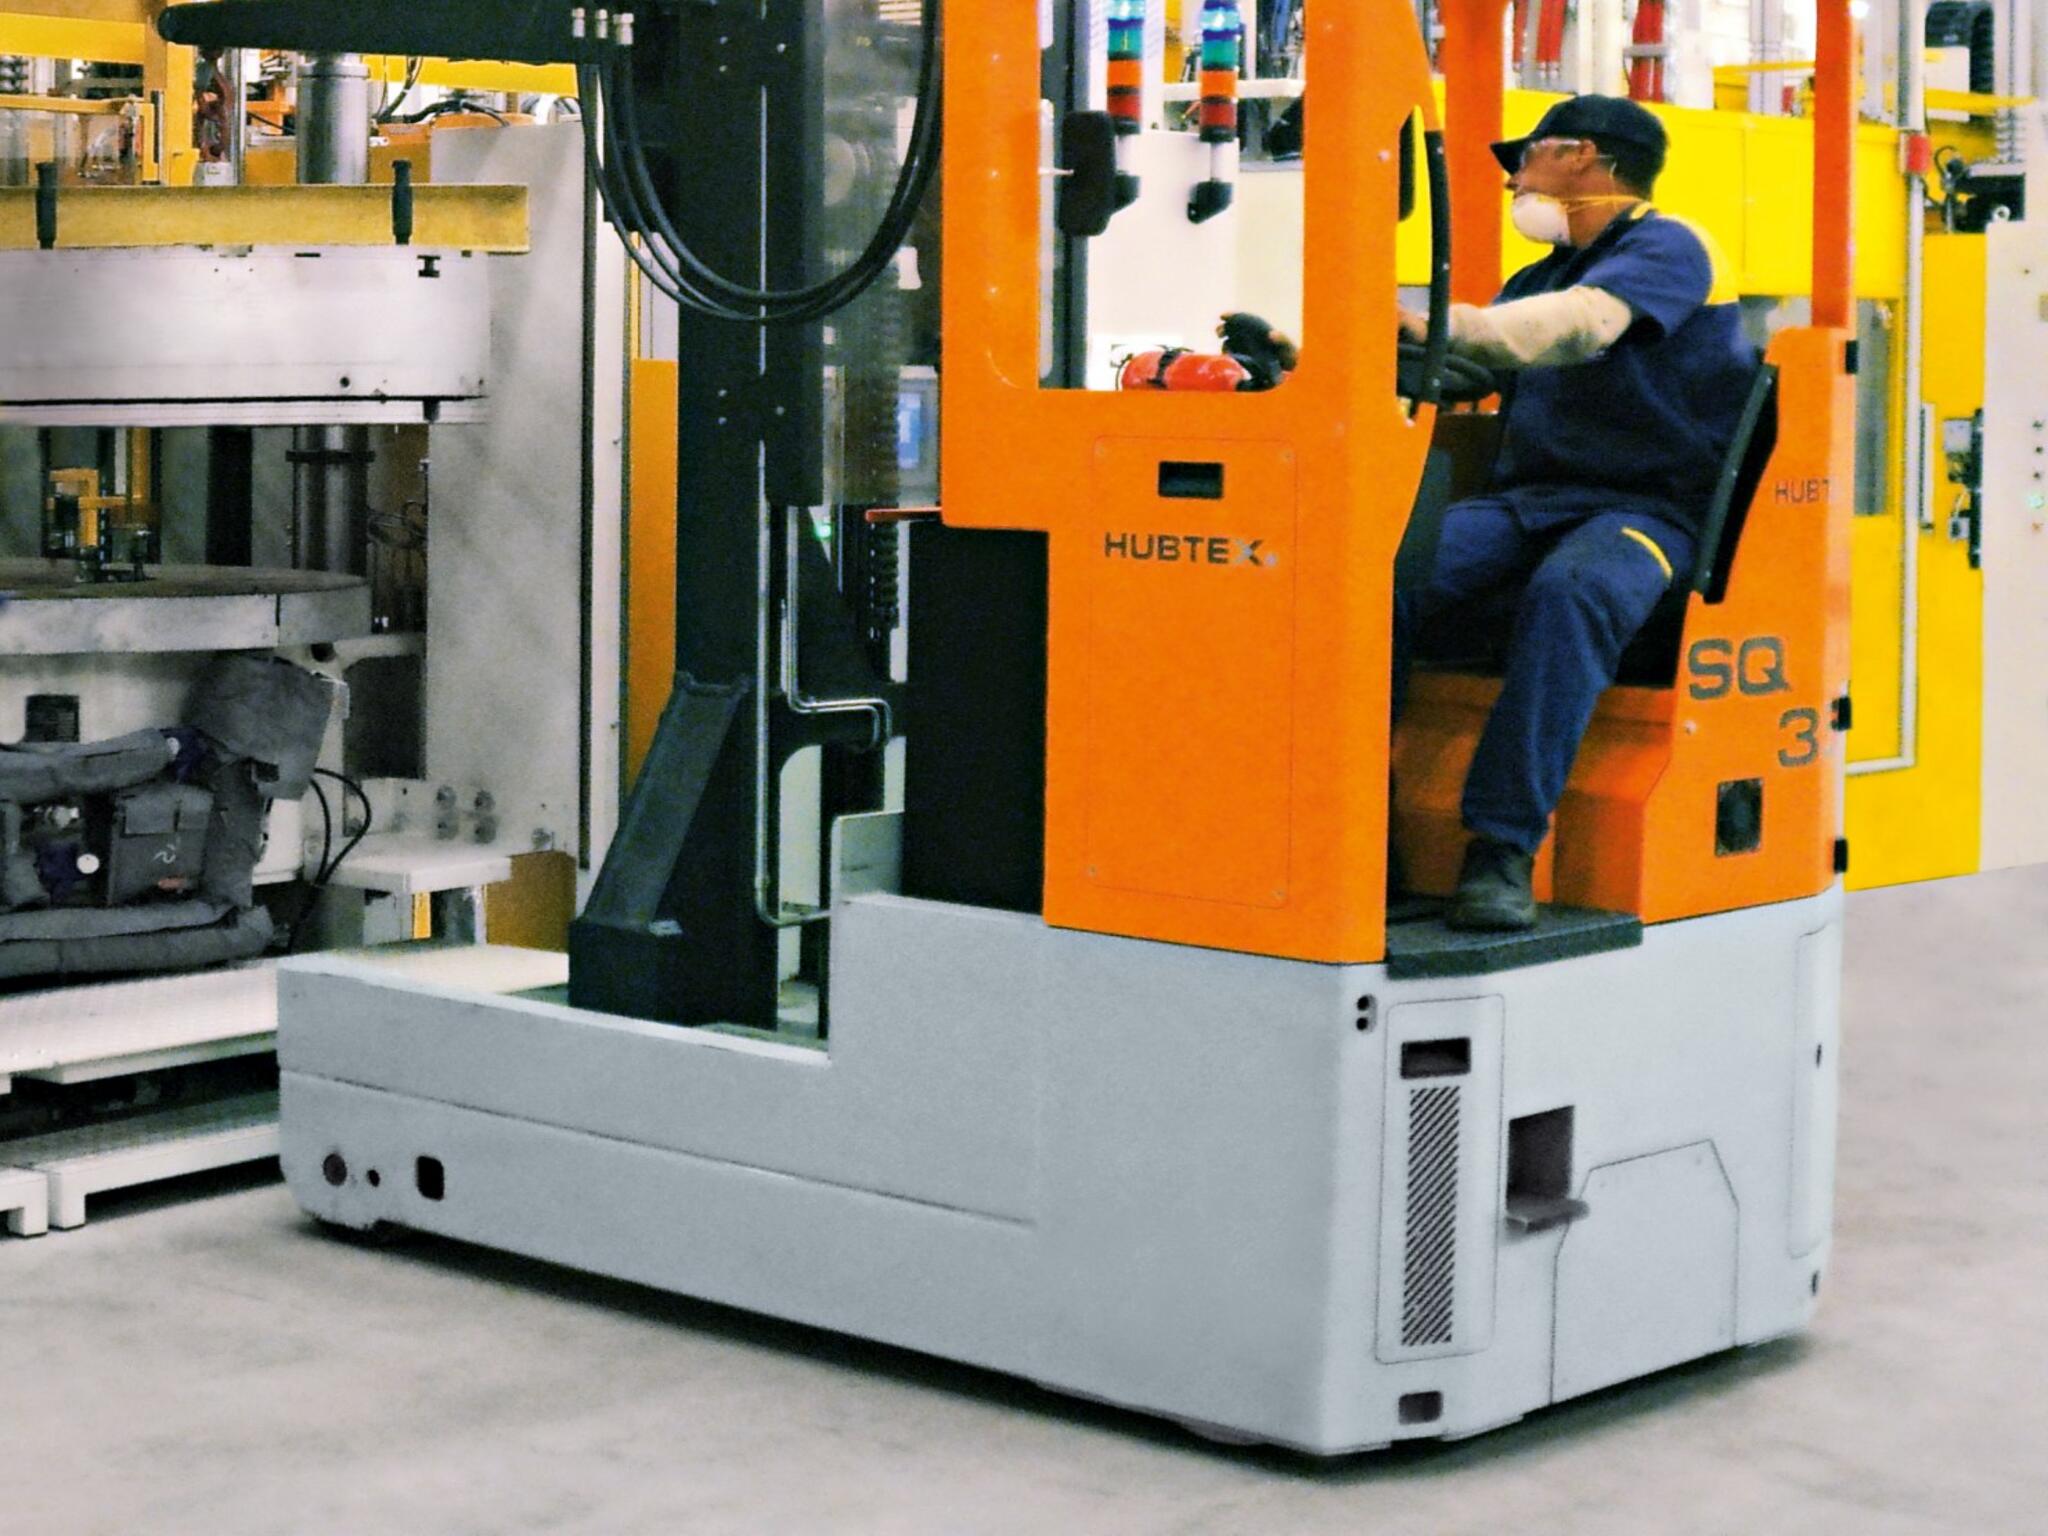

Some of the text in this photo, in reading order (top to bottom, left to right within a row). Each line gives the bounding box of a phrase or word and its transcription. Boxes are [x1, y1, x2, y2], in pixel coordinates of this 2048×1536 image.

[1104, 532, 1263, 566] HUBTEX
[1688, 636, 1789, 700] SQ
[1777, 707, 1819, 767] 3
